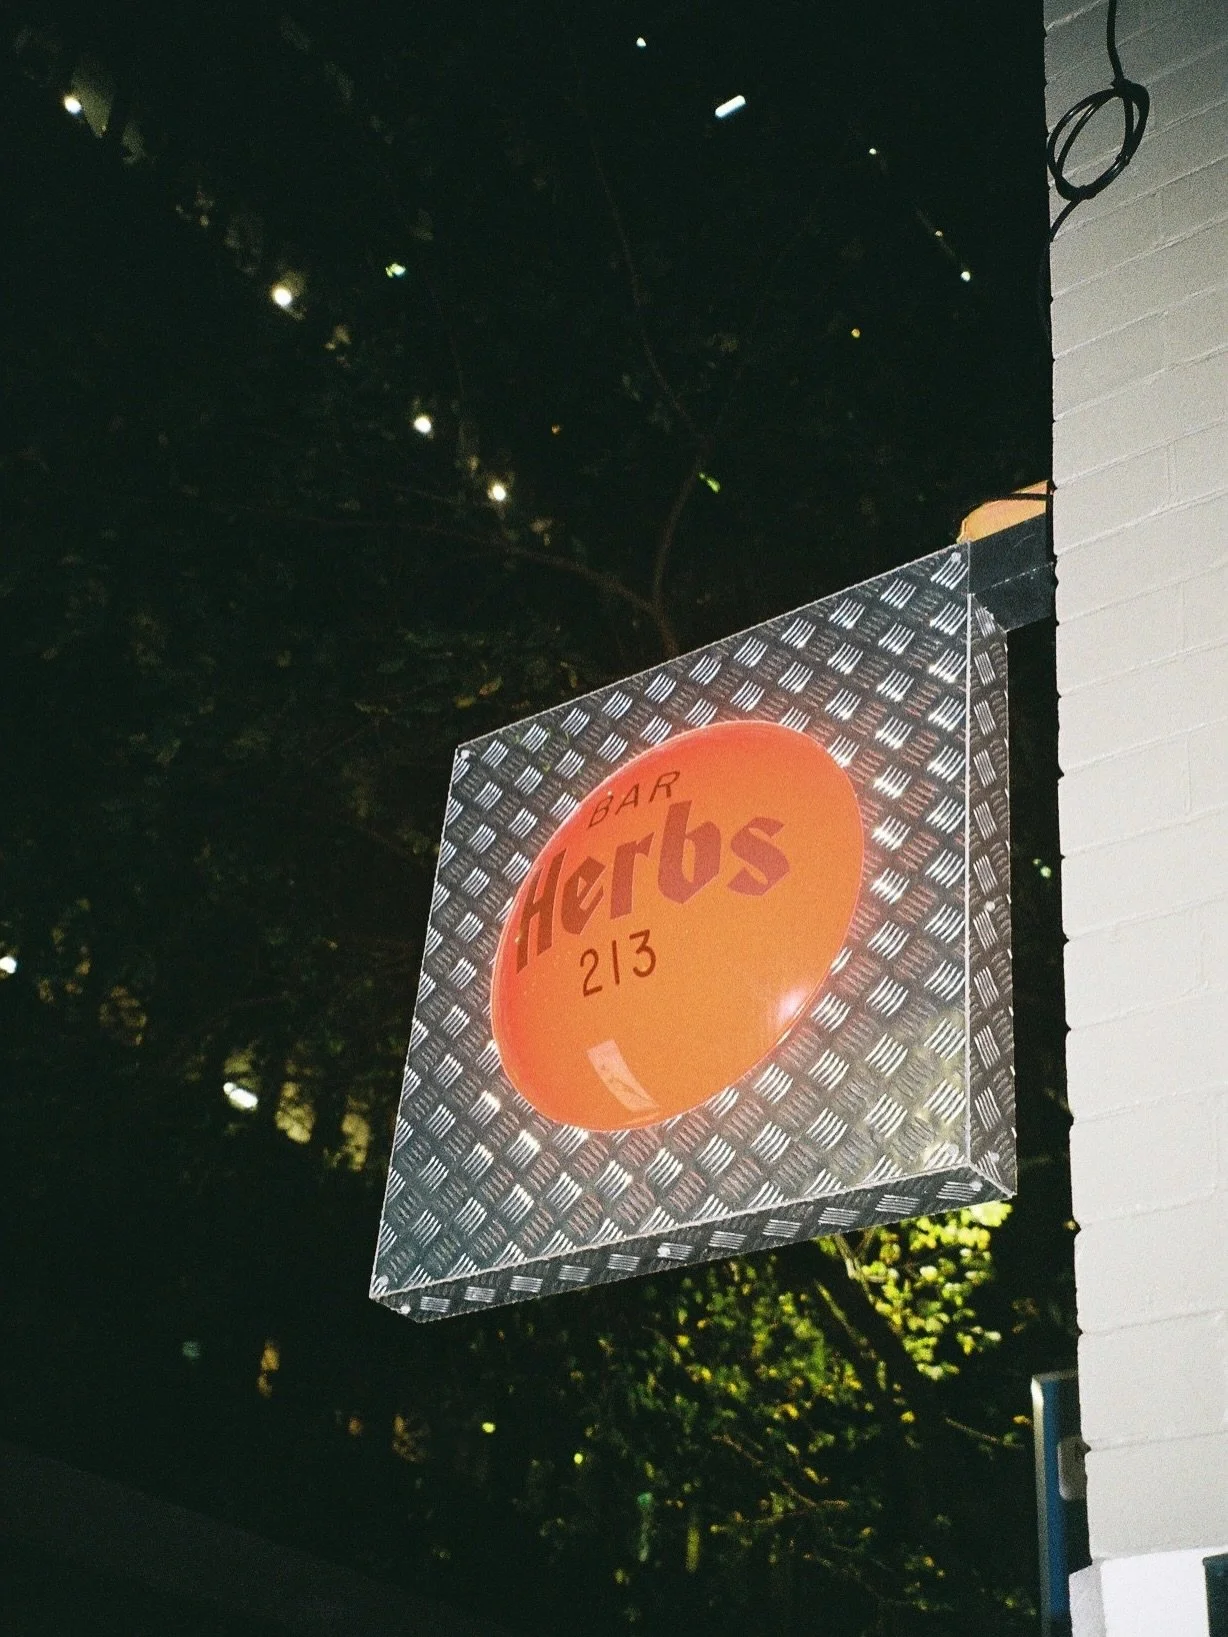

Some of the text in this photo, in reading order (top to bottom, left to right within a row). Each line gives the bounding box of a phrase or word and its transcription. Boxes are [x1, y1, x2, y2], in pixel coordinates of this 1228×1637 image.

[588, 771, 680, 829] BAR
[516, 800, 791, 975] Herbs
[579, 929, 656, 997] 213
